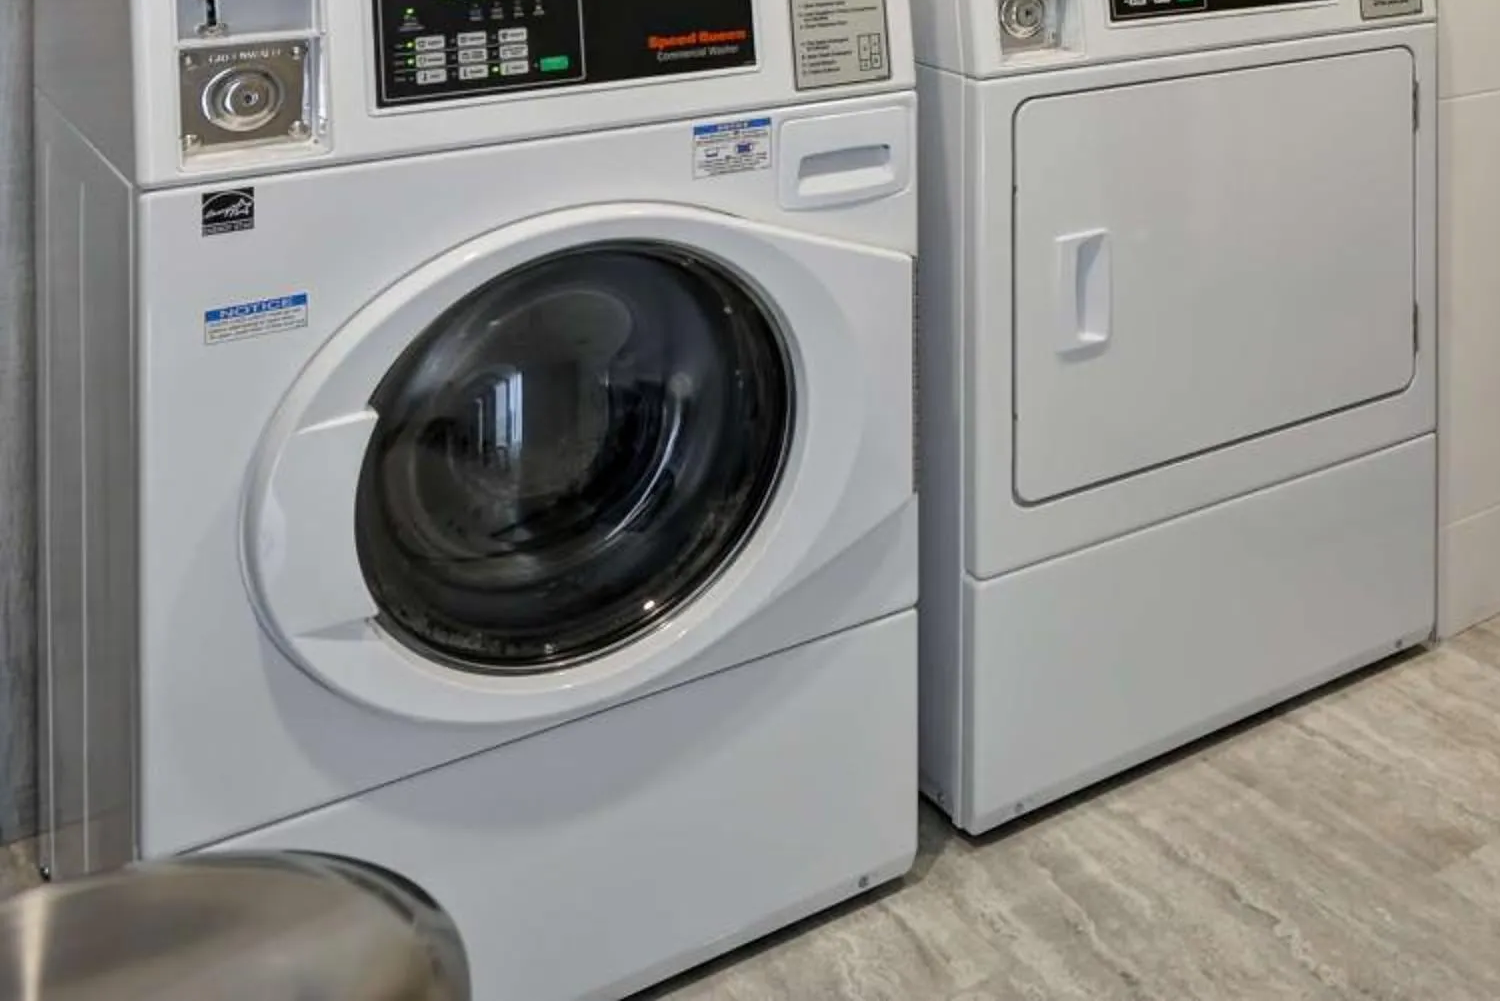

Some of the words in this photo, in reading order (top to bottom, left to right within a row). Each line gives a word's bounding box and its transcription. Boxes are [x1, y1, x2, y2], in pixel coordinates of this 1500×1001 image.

[648, 31, 697, 50] Speed
[699, 29, 746, 42] Queen
[657, 48, 706, 62] Commercial
[708, 46, 739, 56] Washer
[219, 296, 293, 320] NOTICE
